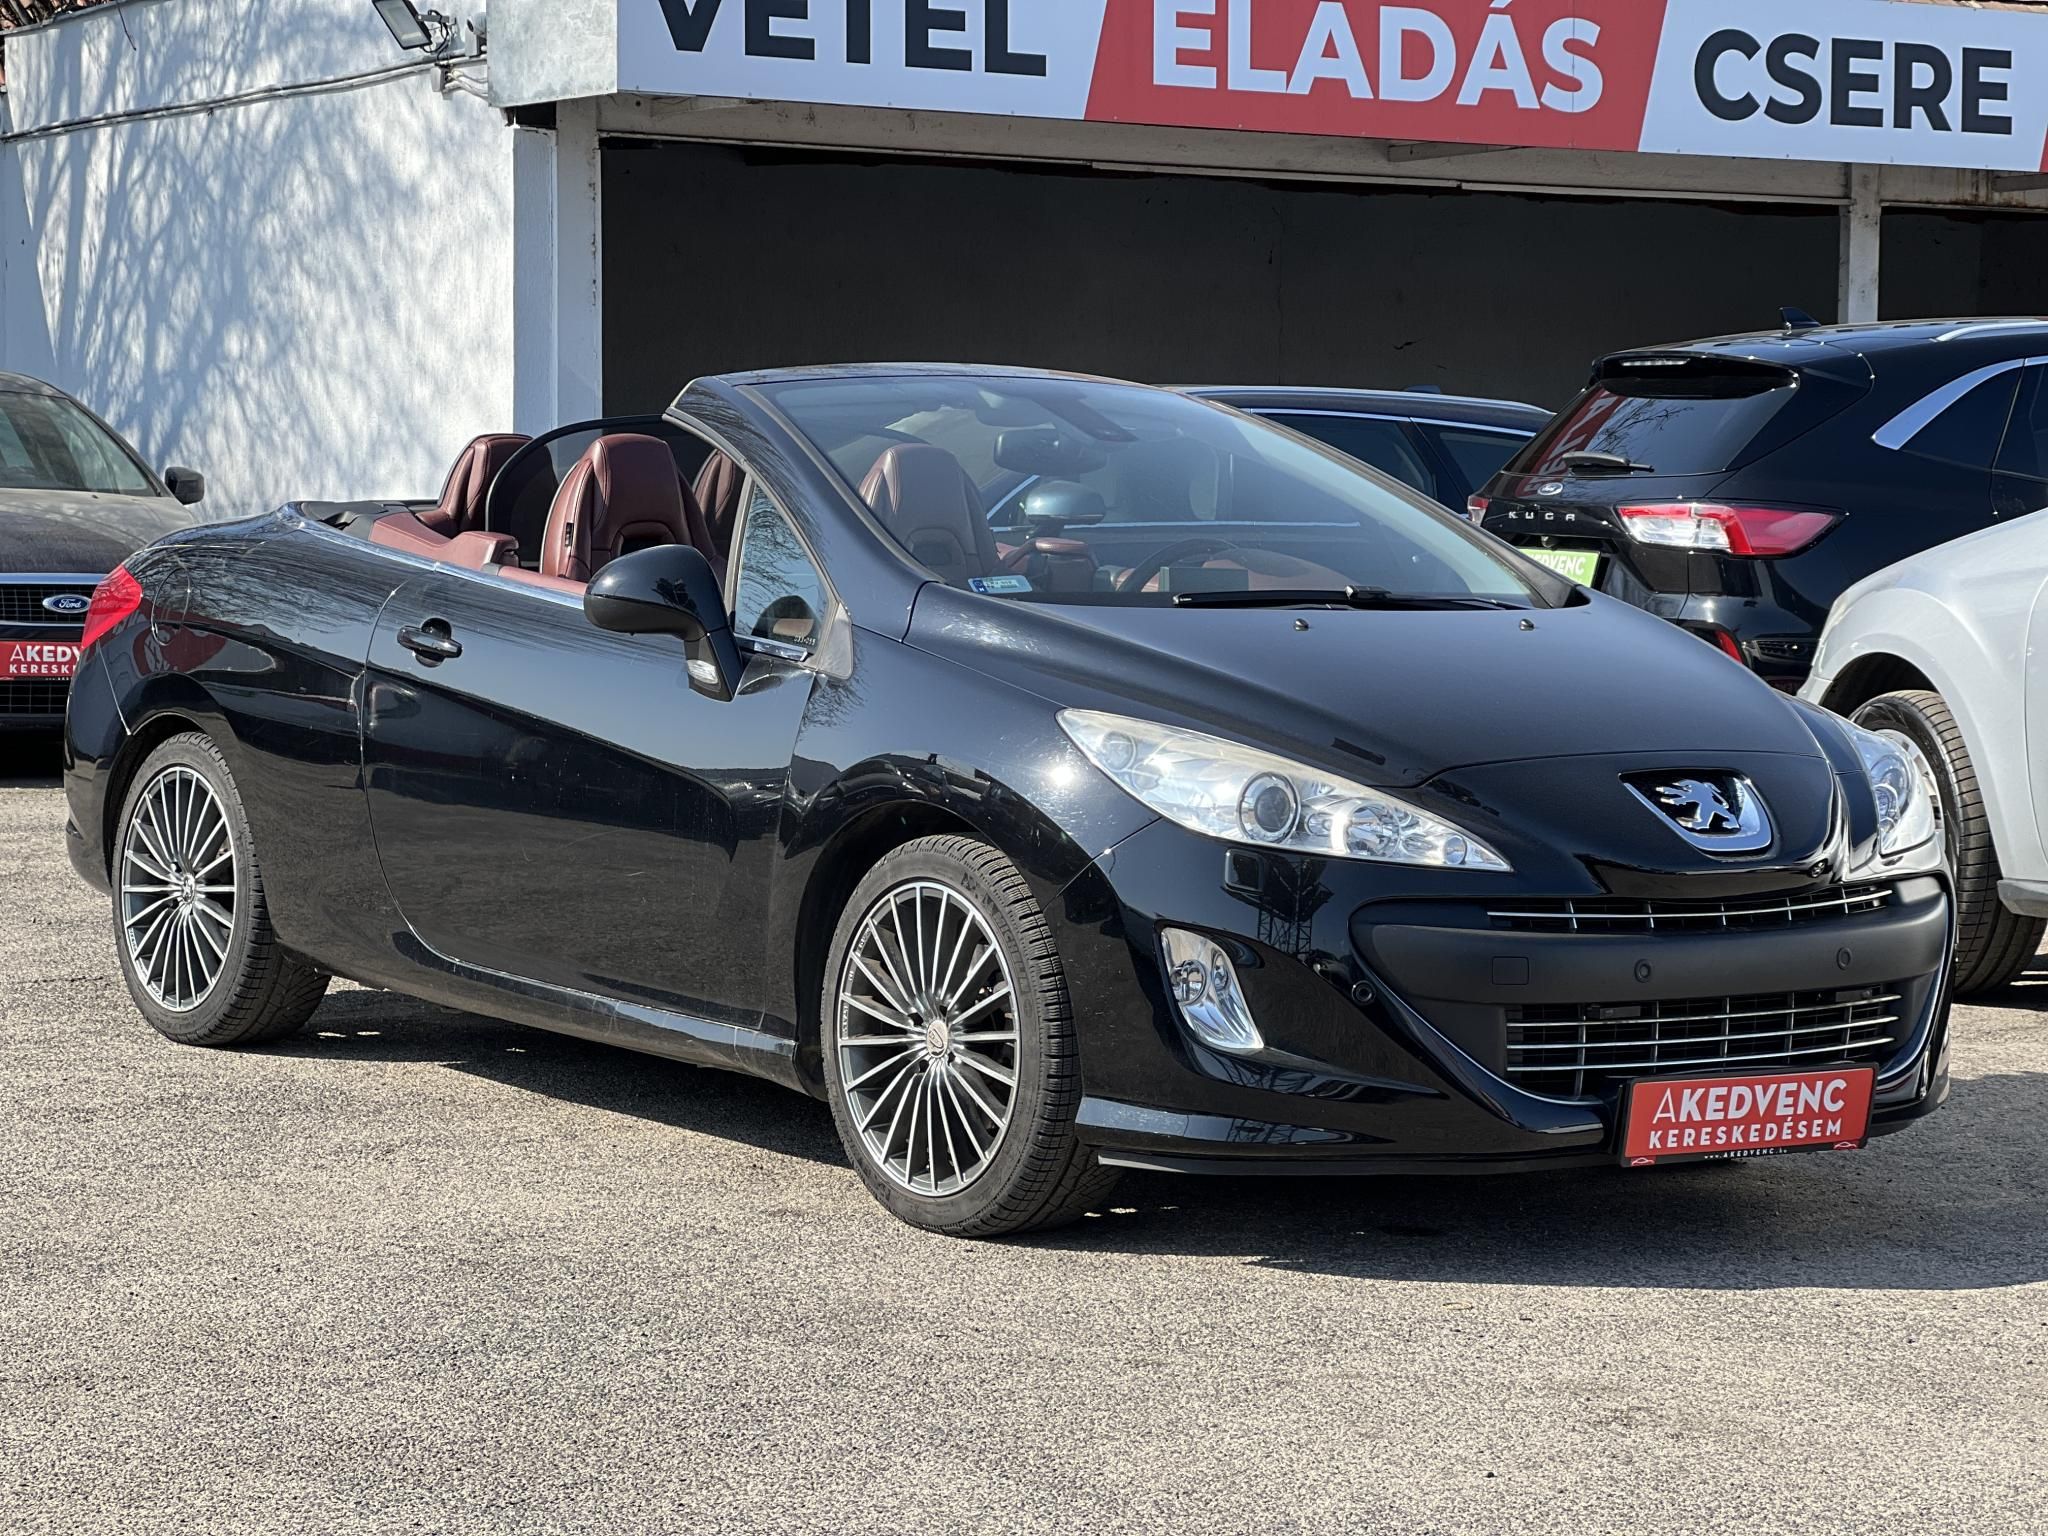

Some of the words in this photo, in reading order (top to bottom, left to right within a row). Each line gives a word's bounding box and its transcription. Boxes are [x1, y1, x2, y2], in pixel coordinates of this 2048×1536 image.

[1152, 0, 1604, 113] ELADÁS
[1694, 28, 2012, 135] CSERE
[1508, 511, 1576, 522] KUGA
[59, 598, 82, 609] Ford
[1648, 1116, 1842, 1150] KERESKEDÉSEM
